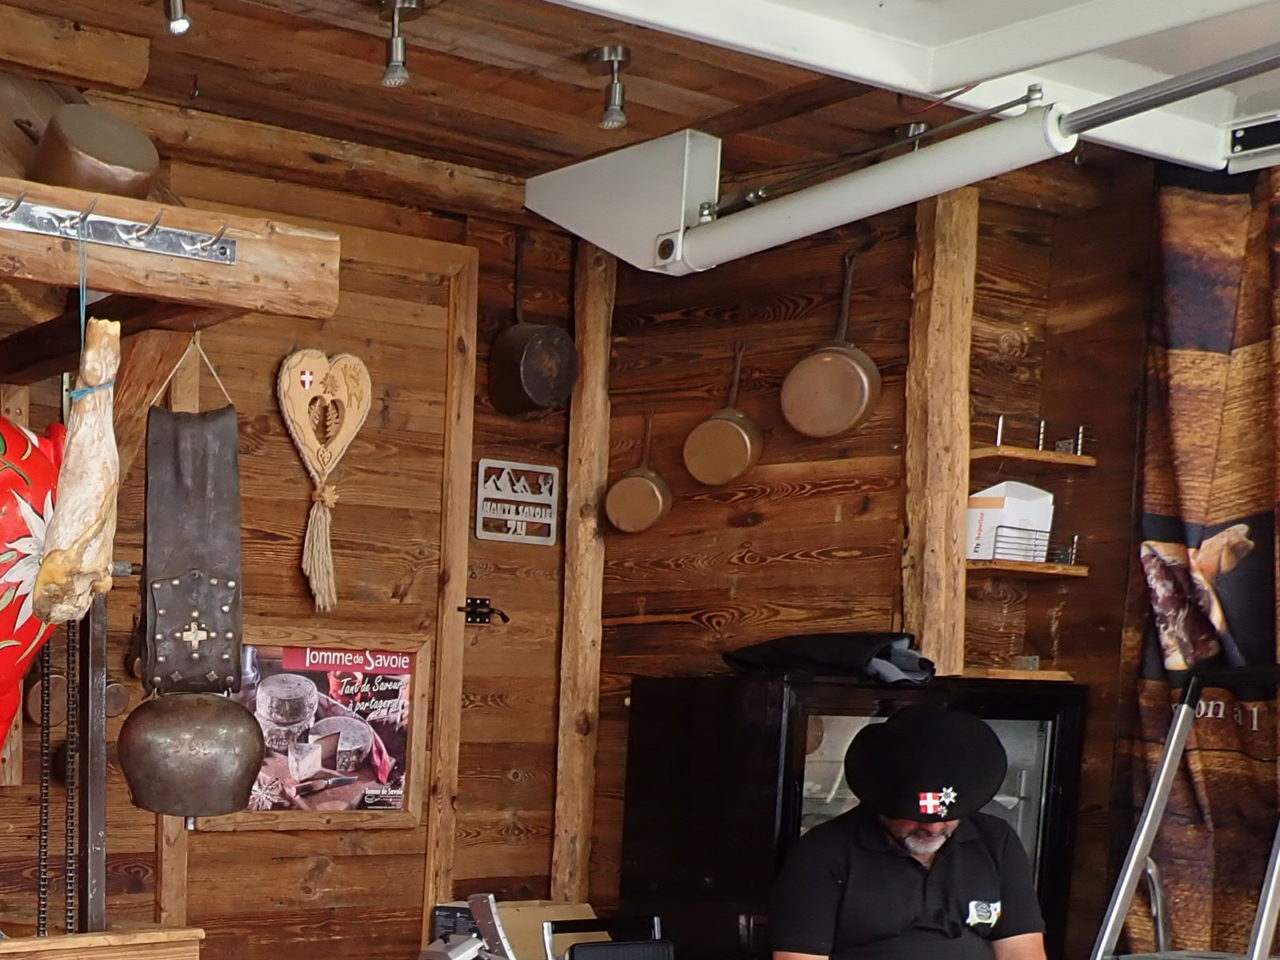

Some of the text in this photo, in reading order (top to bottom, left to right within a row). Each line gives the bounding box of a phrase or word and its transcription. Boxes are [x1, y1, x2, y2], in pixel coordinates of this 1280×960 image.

[482, 501, 552, 519] HAUTE SAVOIE
[507, 520, 527, 537] 74
[353, 655, 364, 665] de
[365, 650, 410, 671] Savoie
